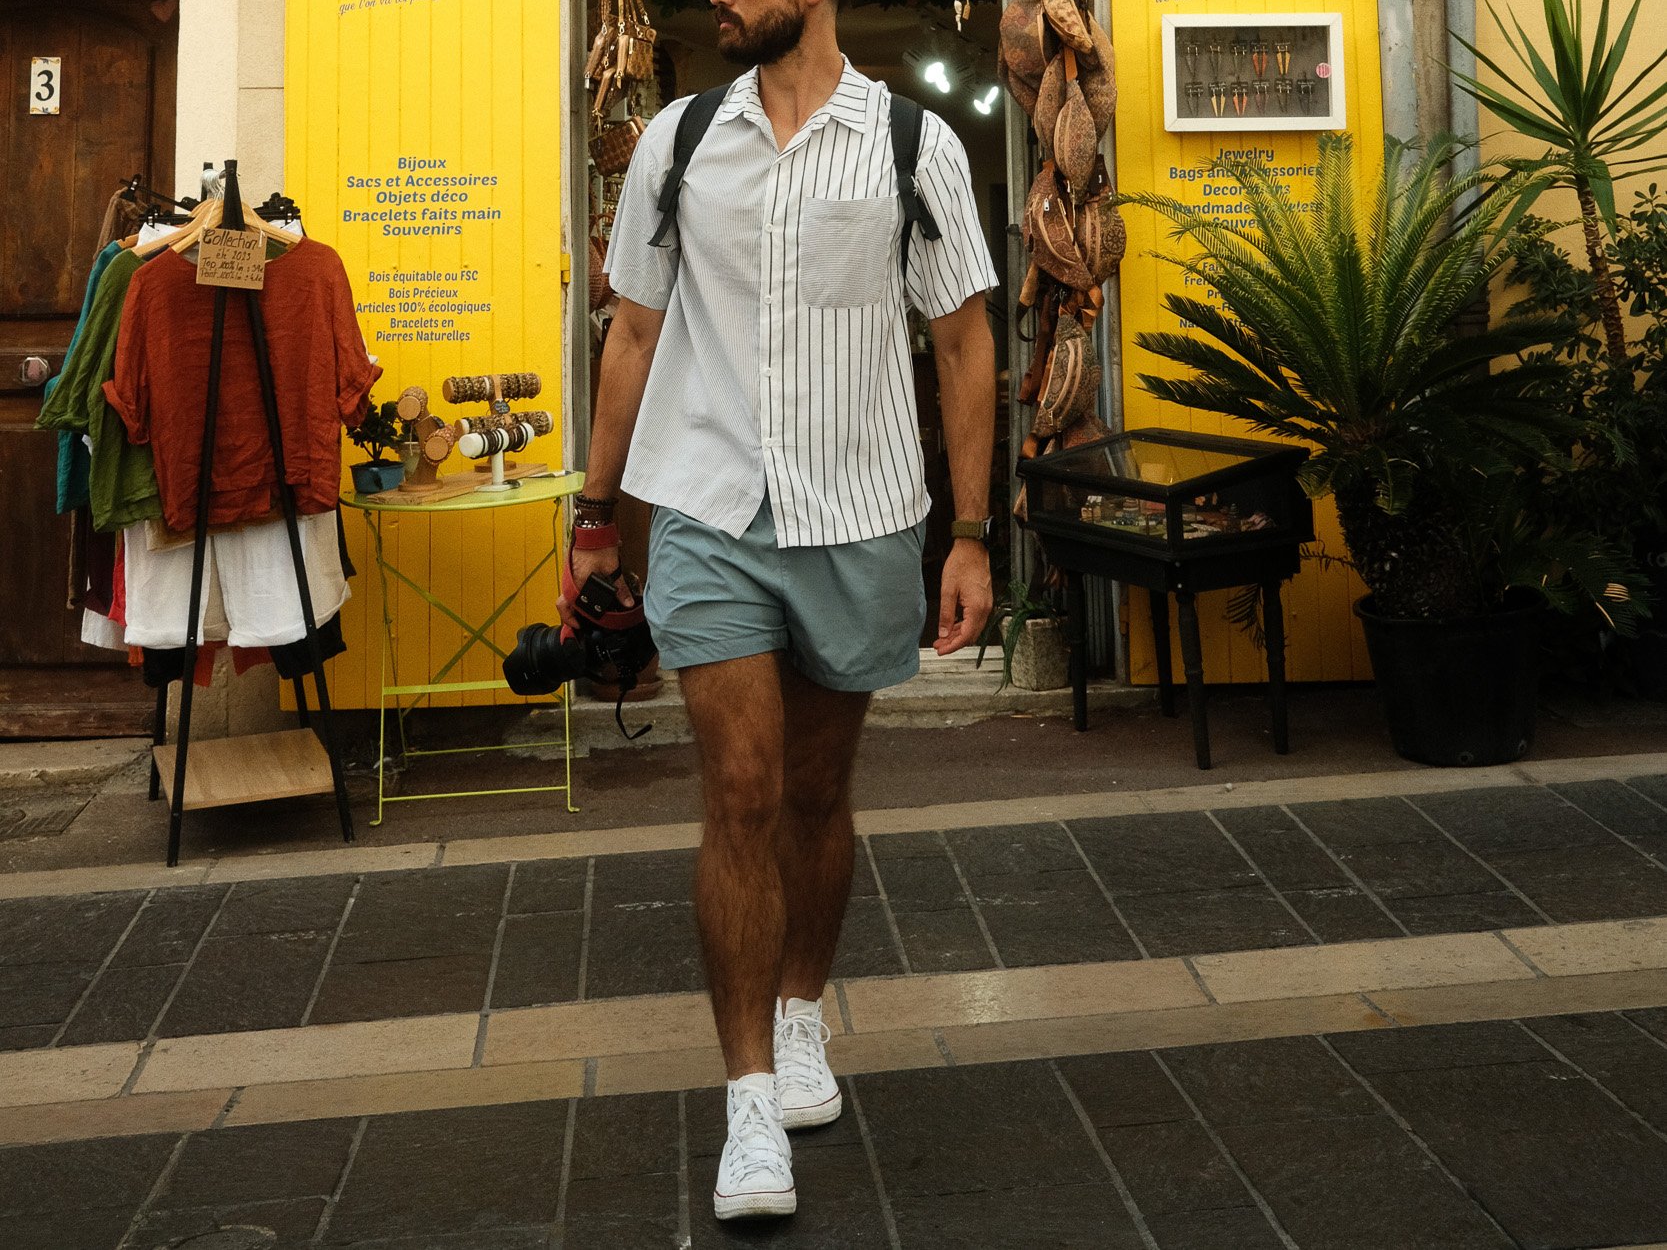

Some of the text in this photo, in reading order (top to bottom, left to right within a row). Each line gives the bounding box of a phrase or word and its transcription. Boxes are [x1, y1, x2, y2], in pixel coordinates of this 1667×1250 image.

[338, 2, 355, 16] que
[35, 70, 54, 101] 3
[1216, 147, 1275, 162] Jewelry
[398, 157, 447, 172] Bijoux
[1169, 166, 1204, 181] Bags
[347, 174, 498, 188] Sacs et Accessoires
[376, 189, 469, 206] Objets déco
[343, 207, 501, 222] Bracelets faits main
[383, 223, 462, 236] Souvenirs
[202, 229, 258, 250] Collection
[369, 270, 479, 284] Bois équitable ou FSC
[389, 286, 458, 299] Bois Précieux
[356, 301, 491, 315] Articles 100% écologiques
[390, 317, 454, 329] Bracelets en
[376, 330, 470, 342] Pierres Naturelles
